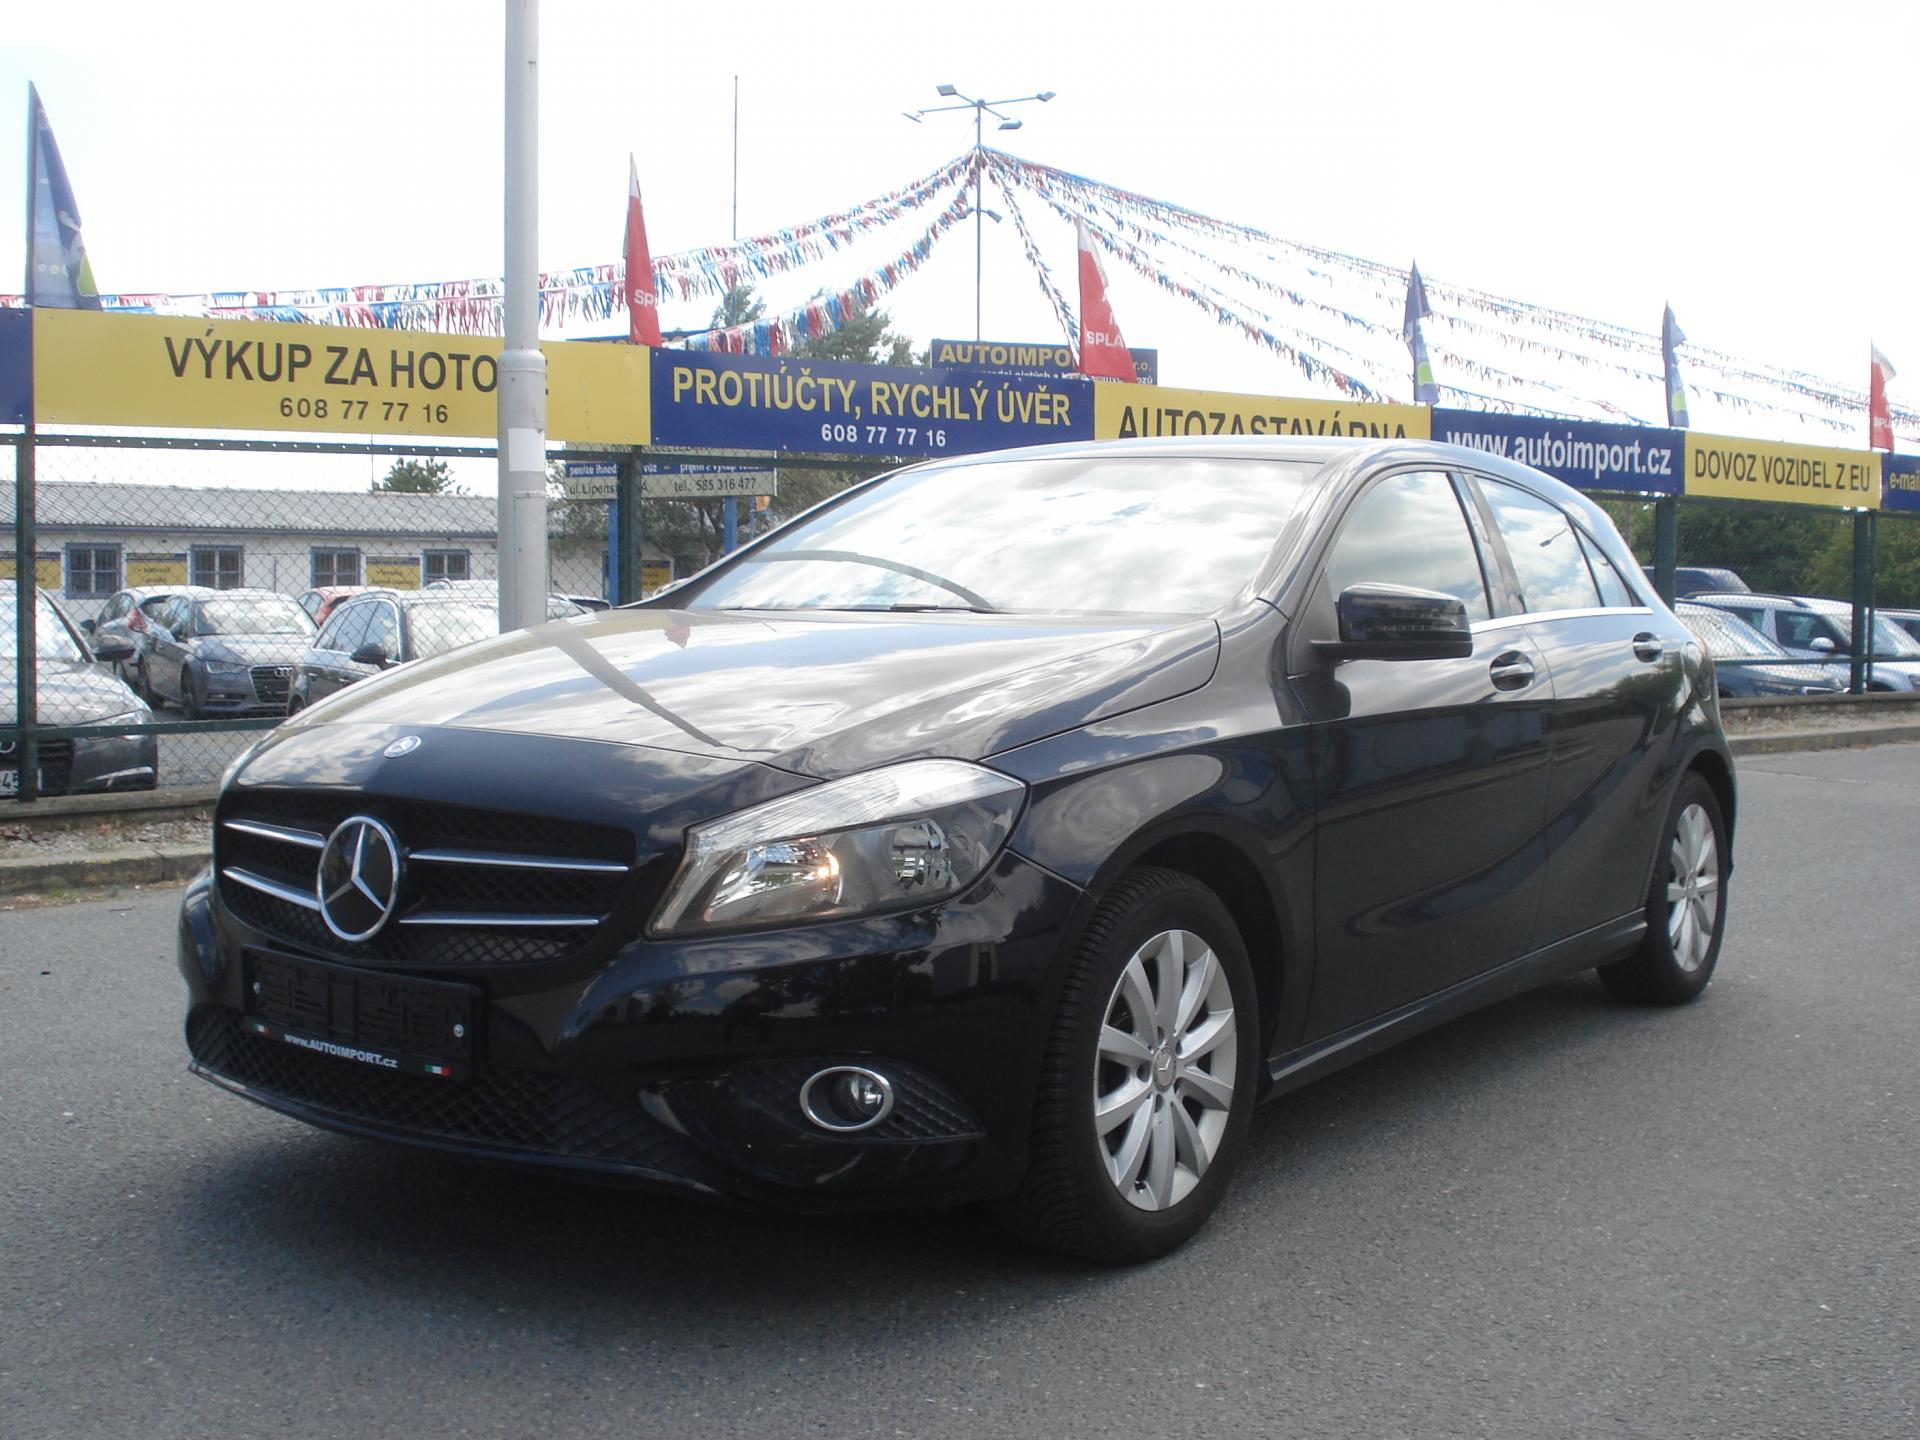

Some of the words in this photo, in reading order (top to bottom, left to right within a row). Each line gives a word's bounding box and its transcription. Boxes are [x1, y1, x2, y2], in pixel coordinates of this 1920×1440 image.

[635, 290, 657, 307] SP
[163, 328, 313, 384] VÝKUP
[325, 346, 378, 387] ZA
[392, 349, 548, 397] HOTO
[938, 343, 1072, 368] AUTOIMPO
[673, 365, 861, 421] PROTIÚČTY,
[871, 380, 989, 421] RYCHLÝ
[997, 383, 1071, 427] ÚVĚR
[280, 397, 328, 420] 608
[341, 399, 368, 421] 77
[382, 401, 410, 422] 77
[423, 403, 448, 424] 16
[821, 423, 858, 443] 608
[866, 425, 887, 444] 77
[896, 427, 918, 446] 77
[926, 429, 947, 448] 16
[1446, 430, 1672, 479] www.autoimport.cz
[1695, 448, 1757, 484] DOVOZ
[1763, 455, 1832, 488] VOZIDEL
[1836, 463, 1847, 491] Z
[1851, 464, 1870, 492] EU
[1889, 470, 1920, 491] e-mai
[696, 479, 714, 492] 585
[717, 478, 736, 491] 316
[738, 477, 757, 490] 477
[284, 1033, 398, 1069] www.AUTOIMPORT.cz
